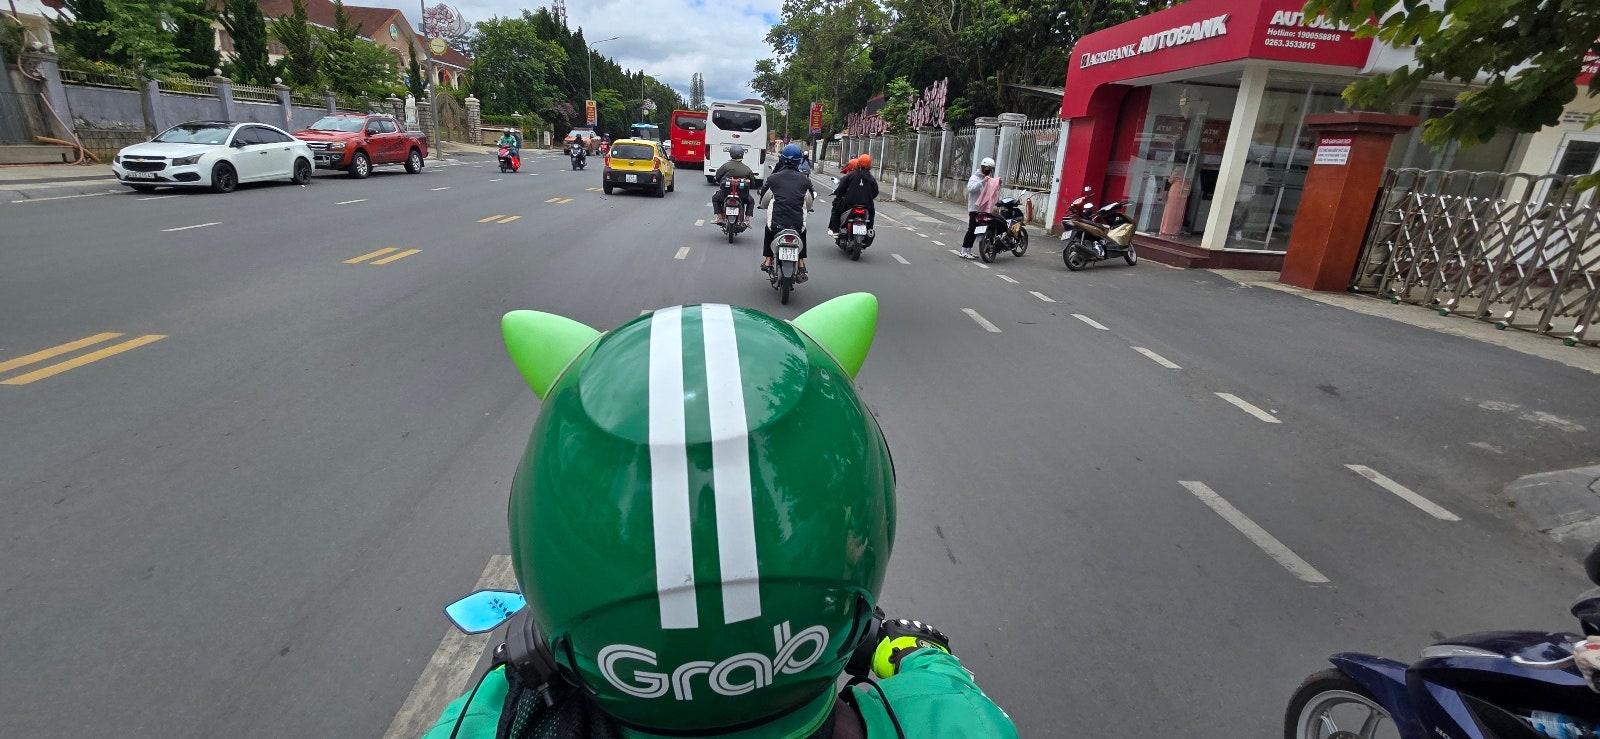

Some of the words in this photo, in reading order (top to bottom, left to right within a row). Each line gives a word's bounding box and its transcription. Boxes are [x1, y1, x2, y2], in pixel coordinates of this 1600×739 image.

[1089, 43, 1137, 66] AGRIBANK
[1137, 13, 1230, 55] AUTOBANK
[1267, 28, 1296, 38] Hotline:
[1297, 31, 1341, 42] 1900558818
[1264, 38, 1317, 50] 0263.3533015
[1156, 124, 1172, 132] ATM
[1203, 127, 1219, 136] ATM
[597, 620, 830, 701] Grab
